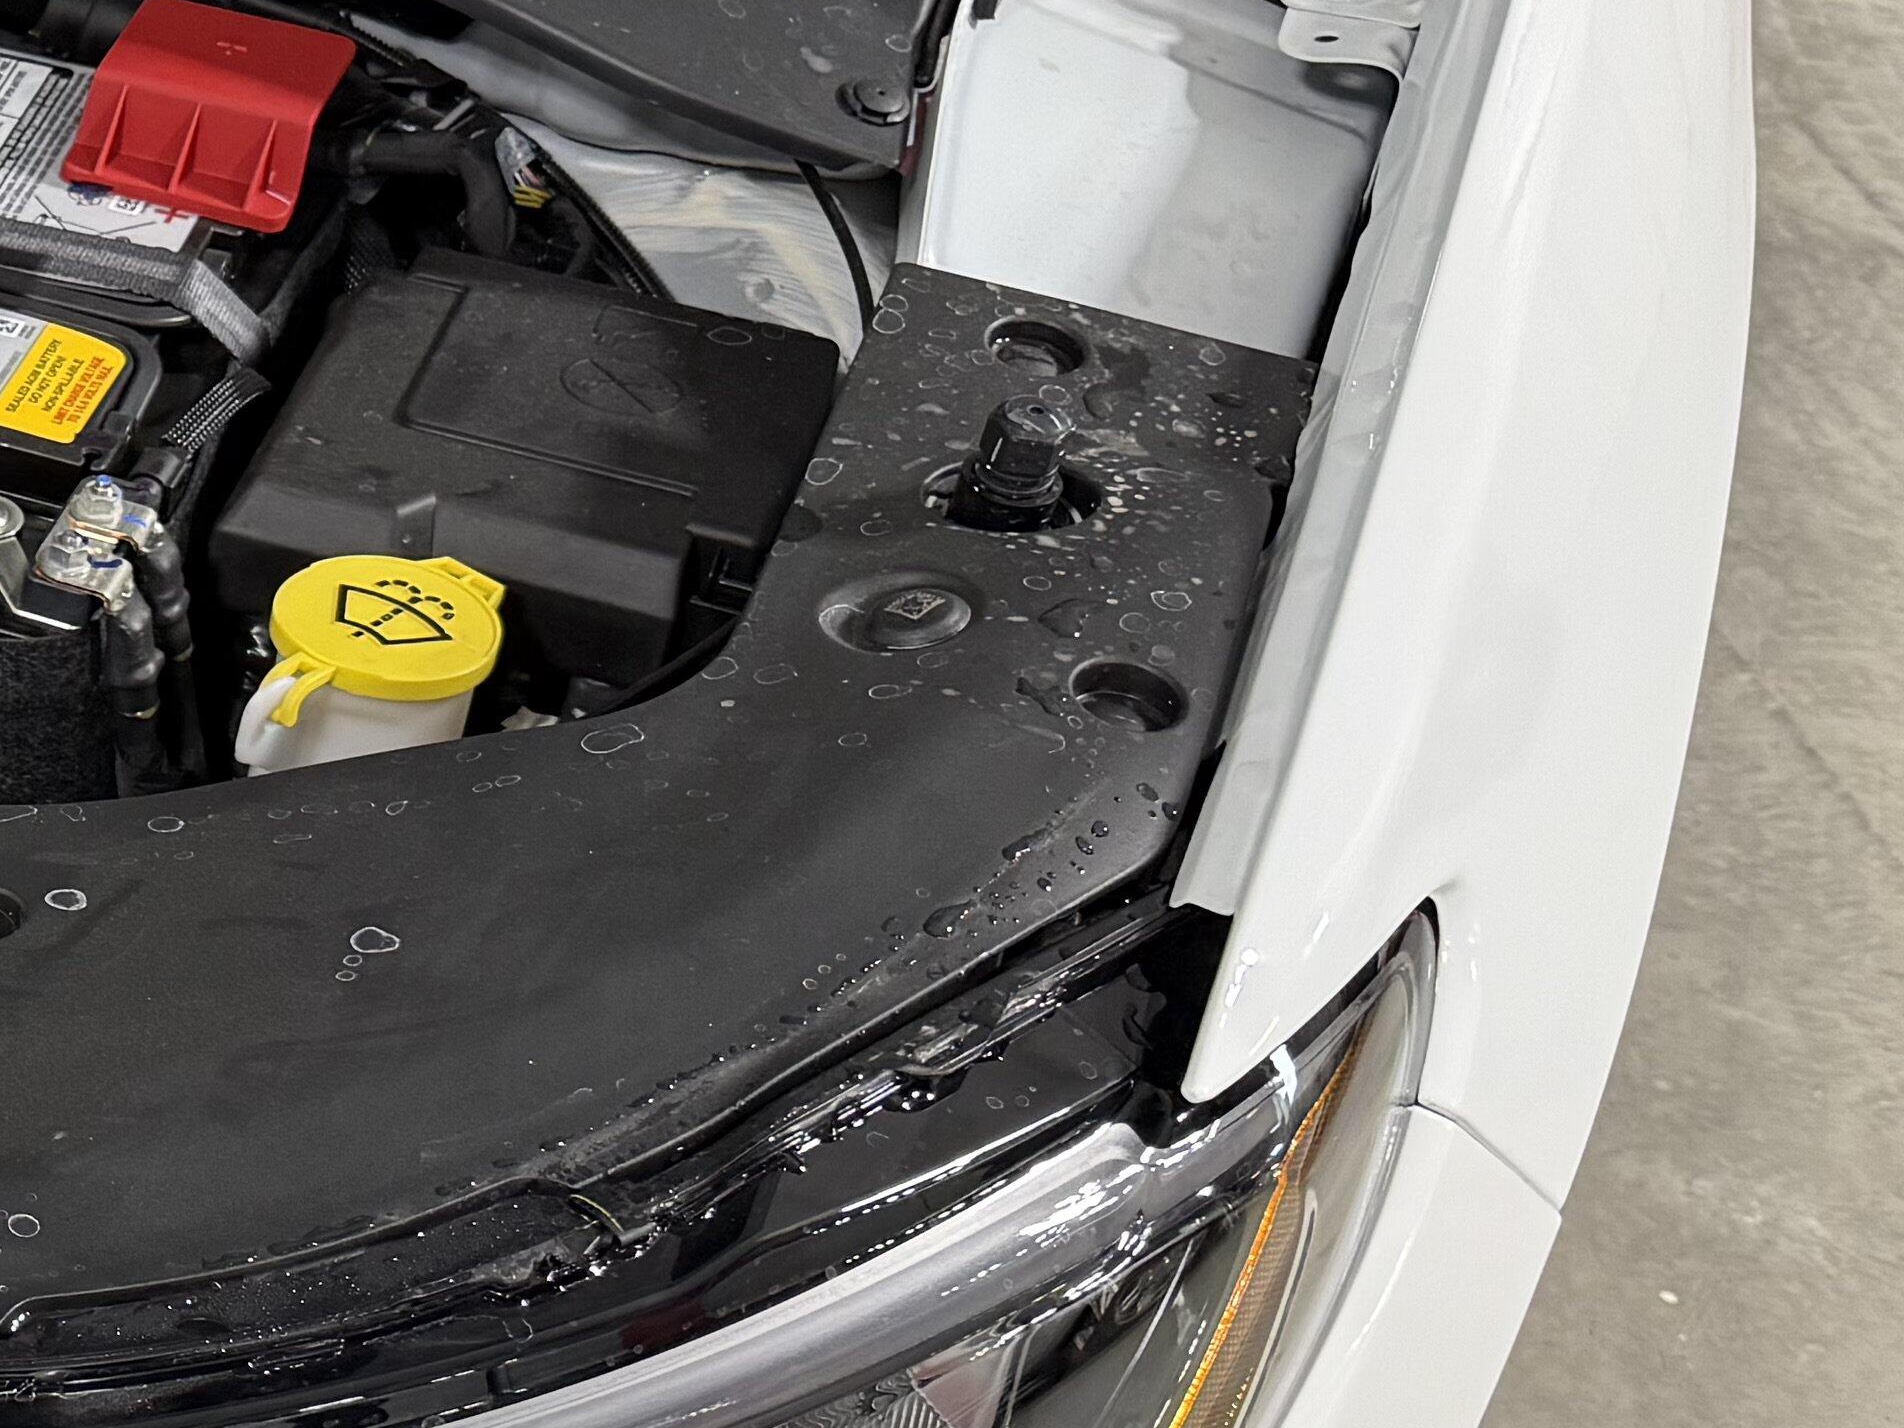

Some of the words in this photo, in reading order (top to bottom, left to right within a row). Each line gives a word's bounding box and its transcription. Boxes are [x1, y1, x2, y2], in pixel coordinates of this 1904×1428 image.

[5, 385, 31, 413] SEALED
[34, 338, 62, 371] BATTERY
[28, 391, 43, 404] DO
[36, 377, 52, 393] NOT
[40, 358, 85, 413] NON-SPILLABLE
